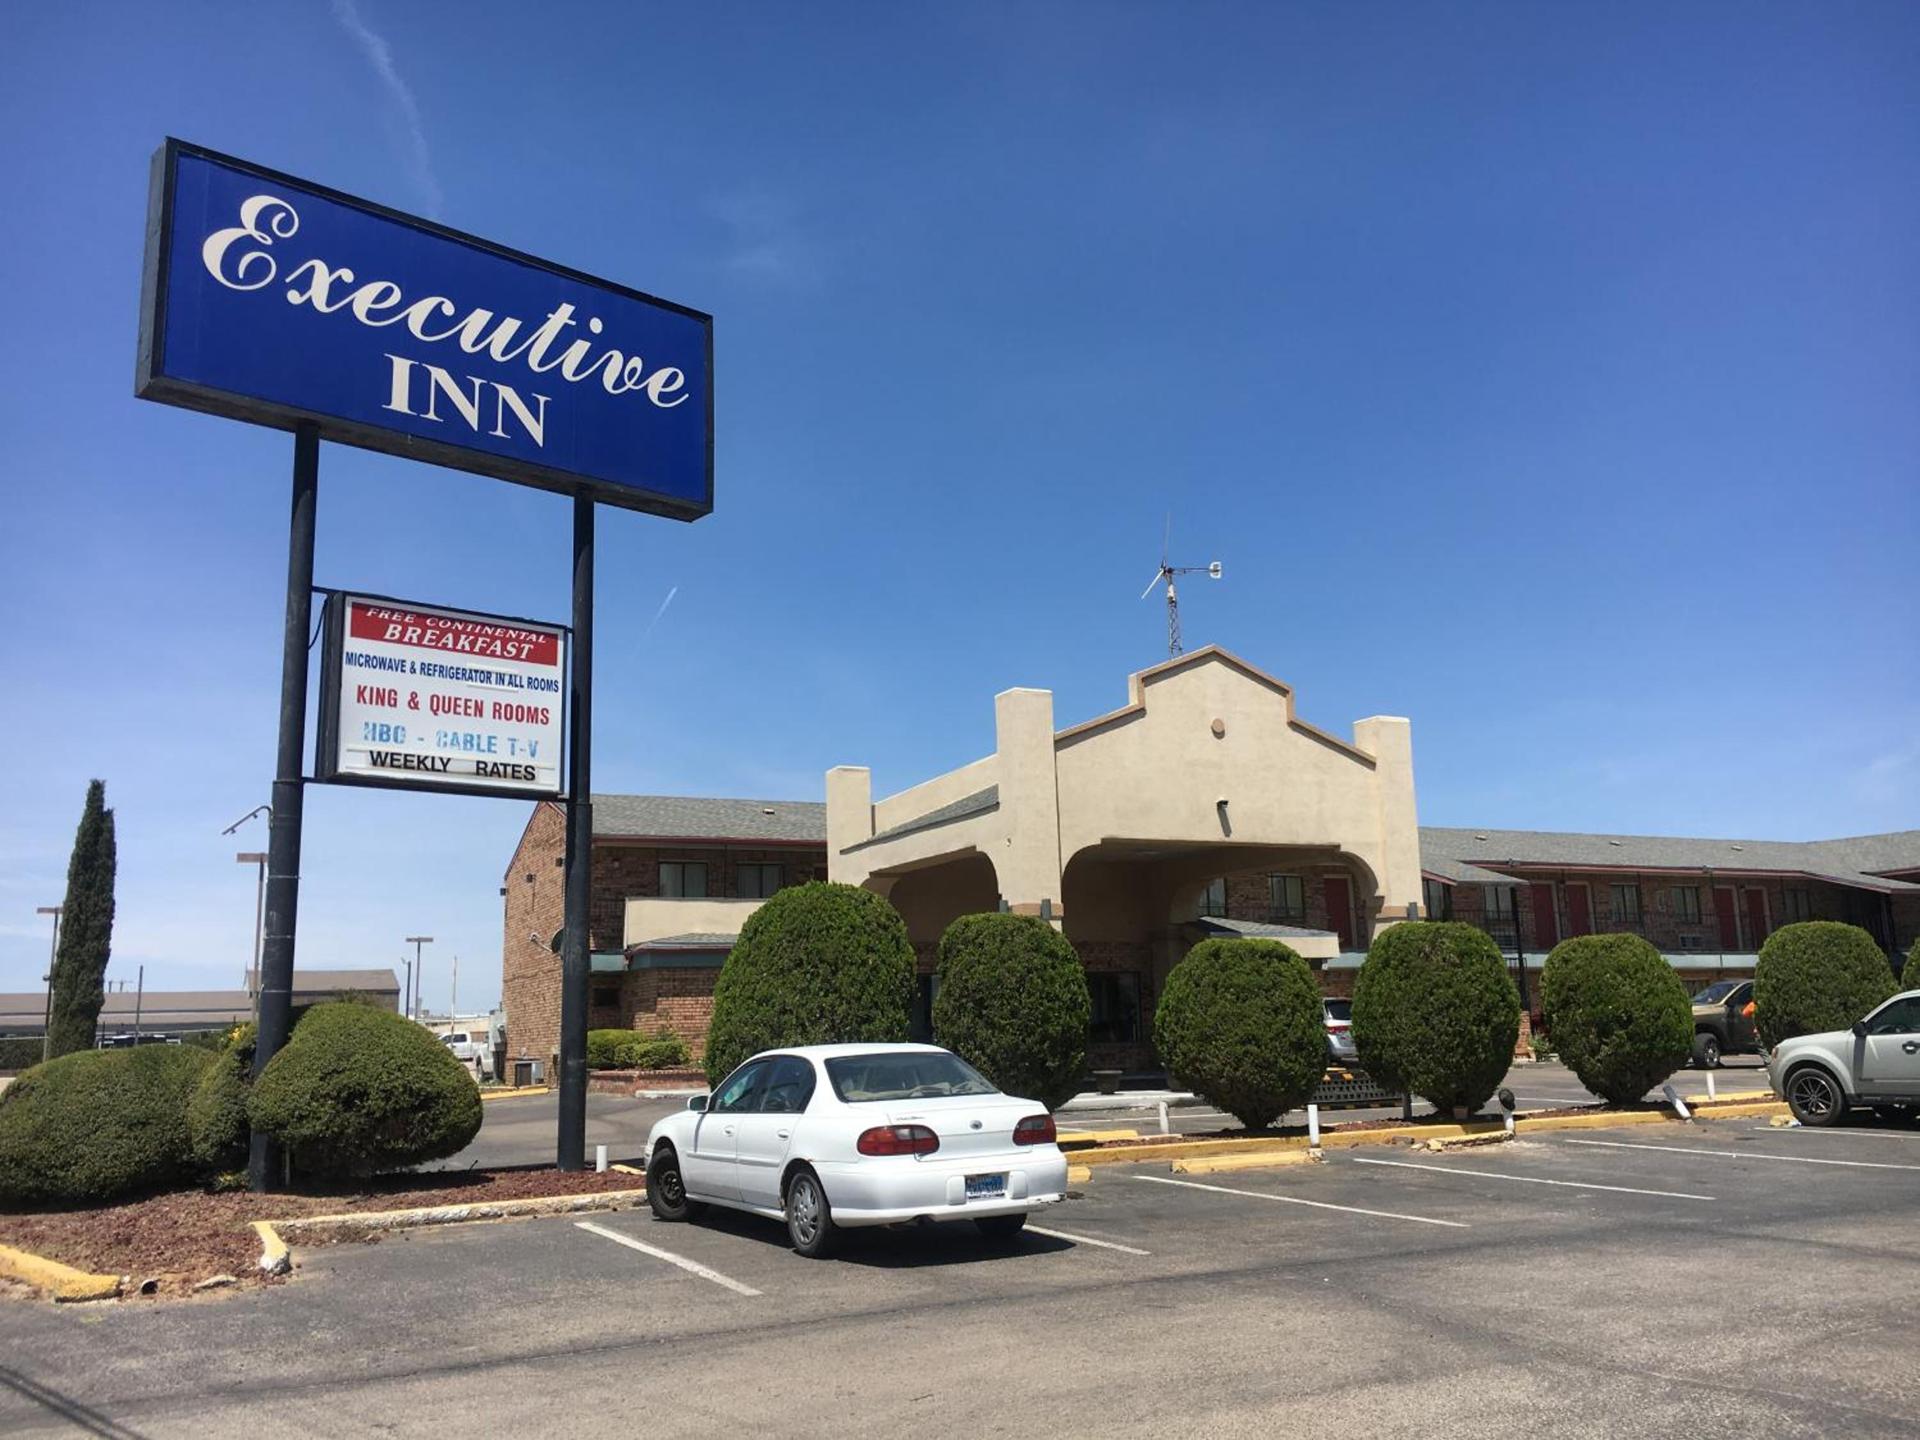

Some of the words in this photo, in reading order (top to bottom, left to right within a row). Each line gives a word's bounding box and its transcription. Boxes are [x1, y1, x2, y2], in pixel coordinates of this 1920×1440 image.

[202, 194, 689, 408] Executive
[382, 353, 551, 448] INN
[366, 607, 417, 624] FREE
[426, 617, 547, 643] CONTINENTAL
[384, 624, 534, 659] BREAKFAST
[345, 651, 407, 675] MICROWAVE
[410, 661, 417, 675] &
[420, 662, 493, 685] REFRIGERATOR
[495, 672, 505, 686] IN
[507, 673, 525, 688] ALL
[527, 677, 559, 693] ROOMS
[356, 685, 398, 708] KING
[407, 691, 420, 710] &
[430, 694, 484, 718] QUEEN
[492, 702, 549, 725] ROOMS
[436, 730, 497, 754] CABLE
[369, 750, 451, 774] WEEKLY
[476, 760, 536, 781] RATES
